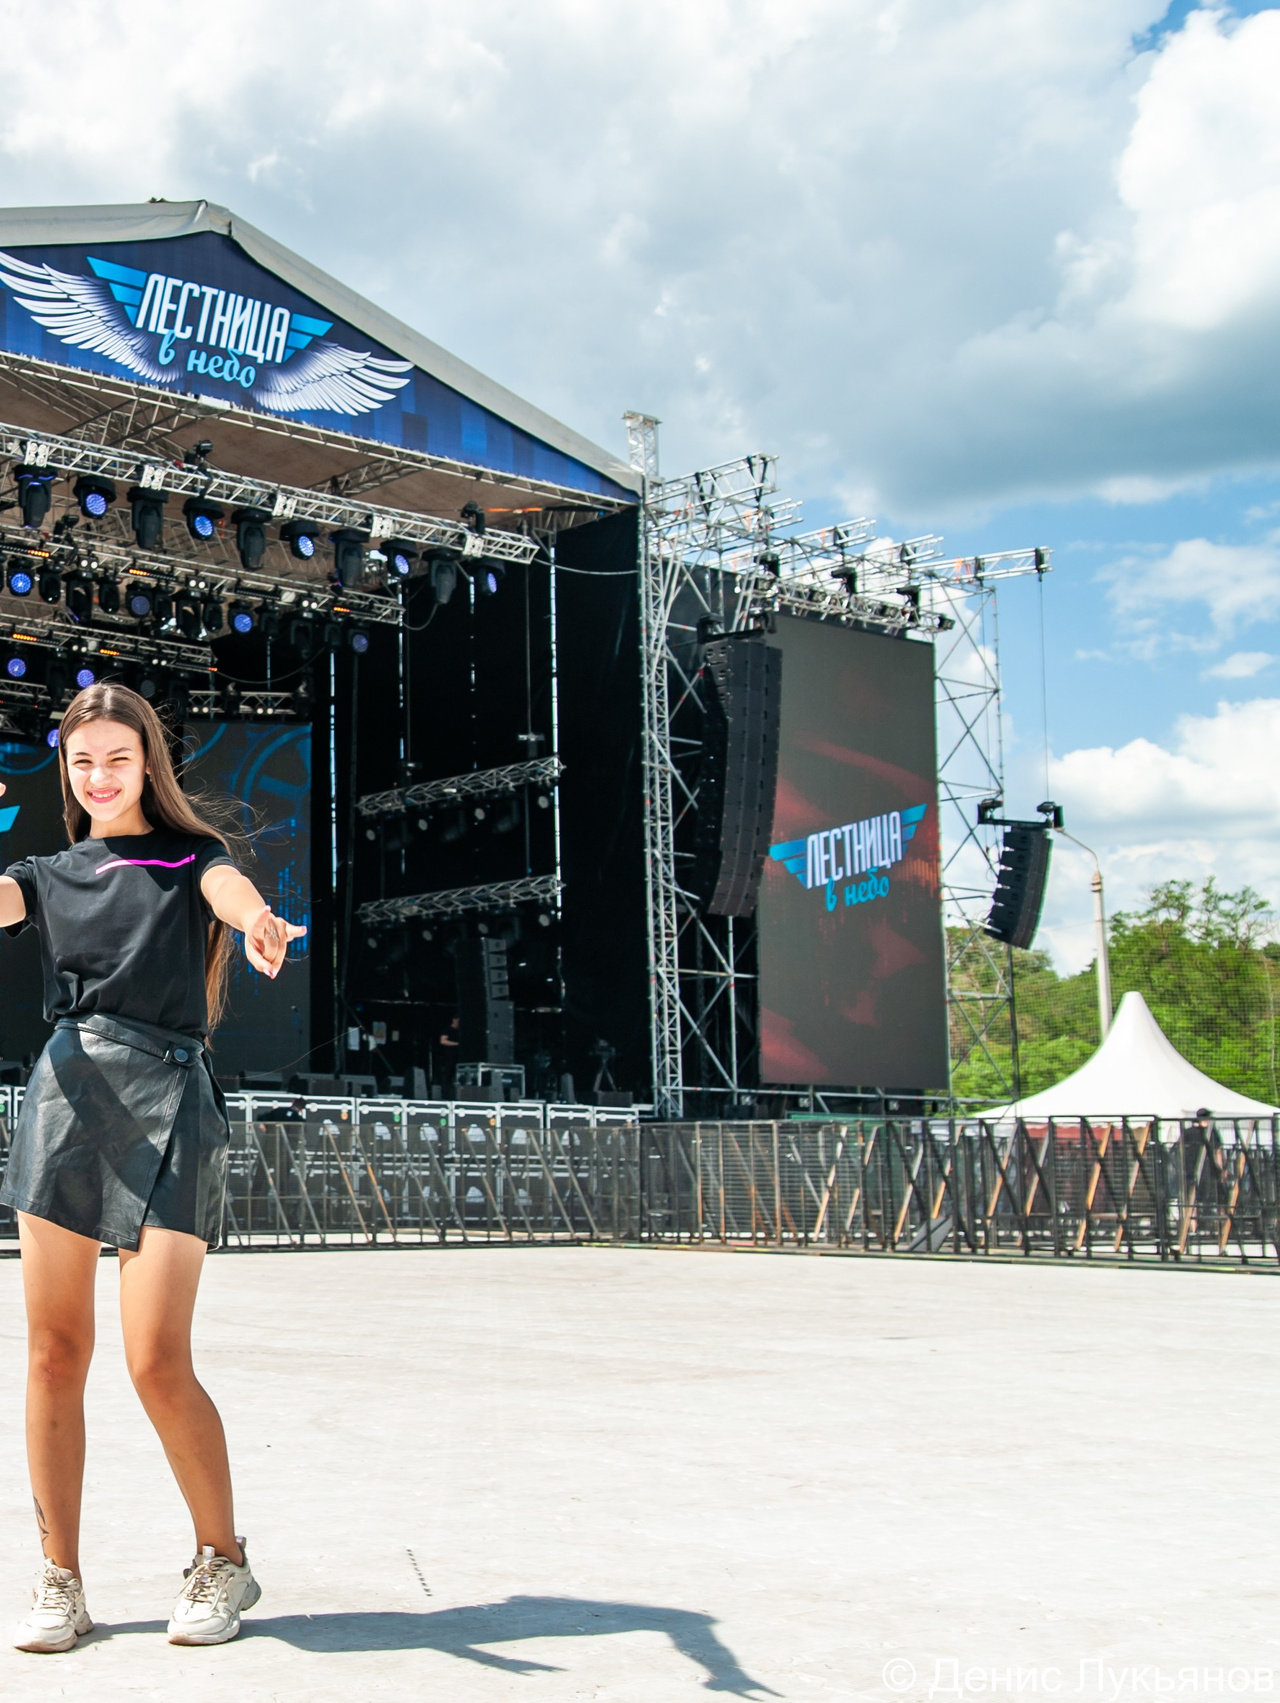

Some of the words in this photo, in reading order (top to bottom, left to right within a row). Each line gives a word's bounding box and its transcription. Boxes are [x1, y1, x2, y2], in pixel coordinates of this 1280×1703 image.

[135, 273, 290, 364] ЛЕСТНИЦА
[158, 330, 176, 366] в
[187, 346, 256, 389] небо
[807, 811, 902, 889] ЛЕСТНИЦА
[825, 877, 837, 912] в
[844, 867, 890, 907] небо
